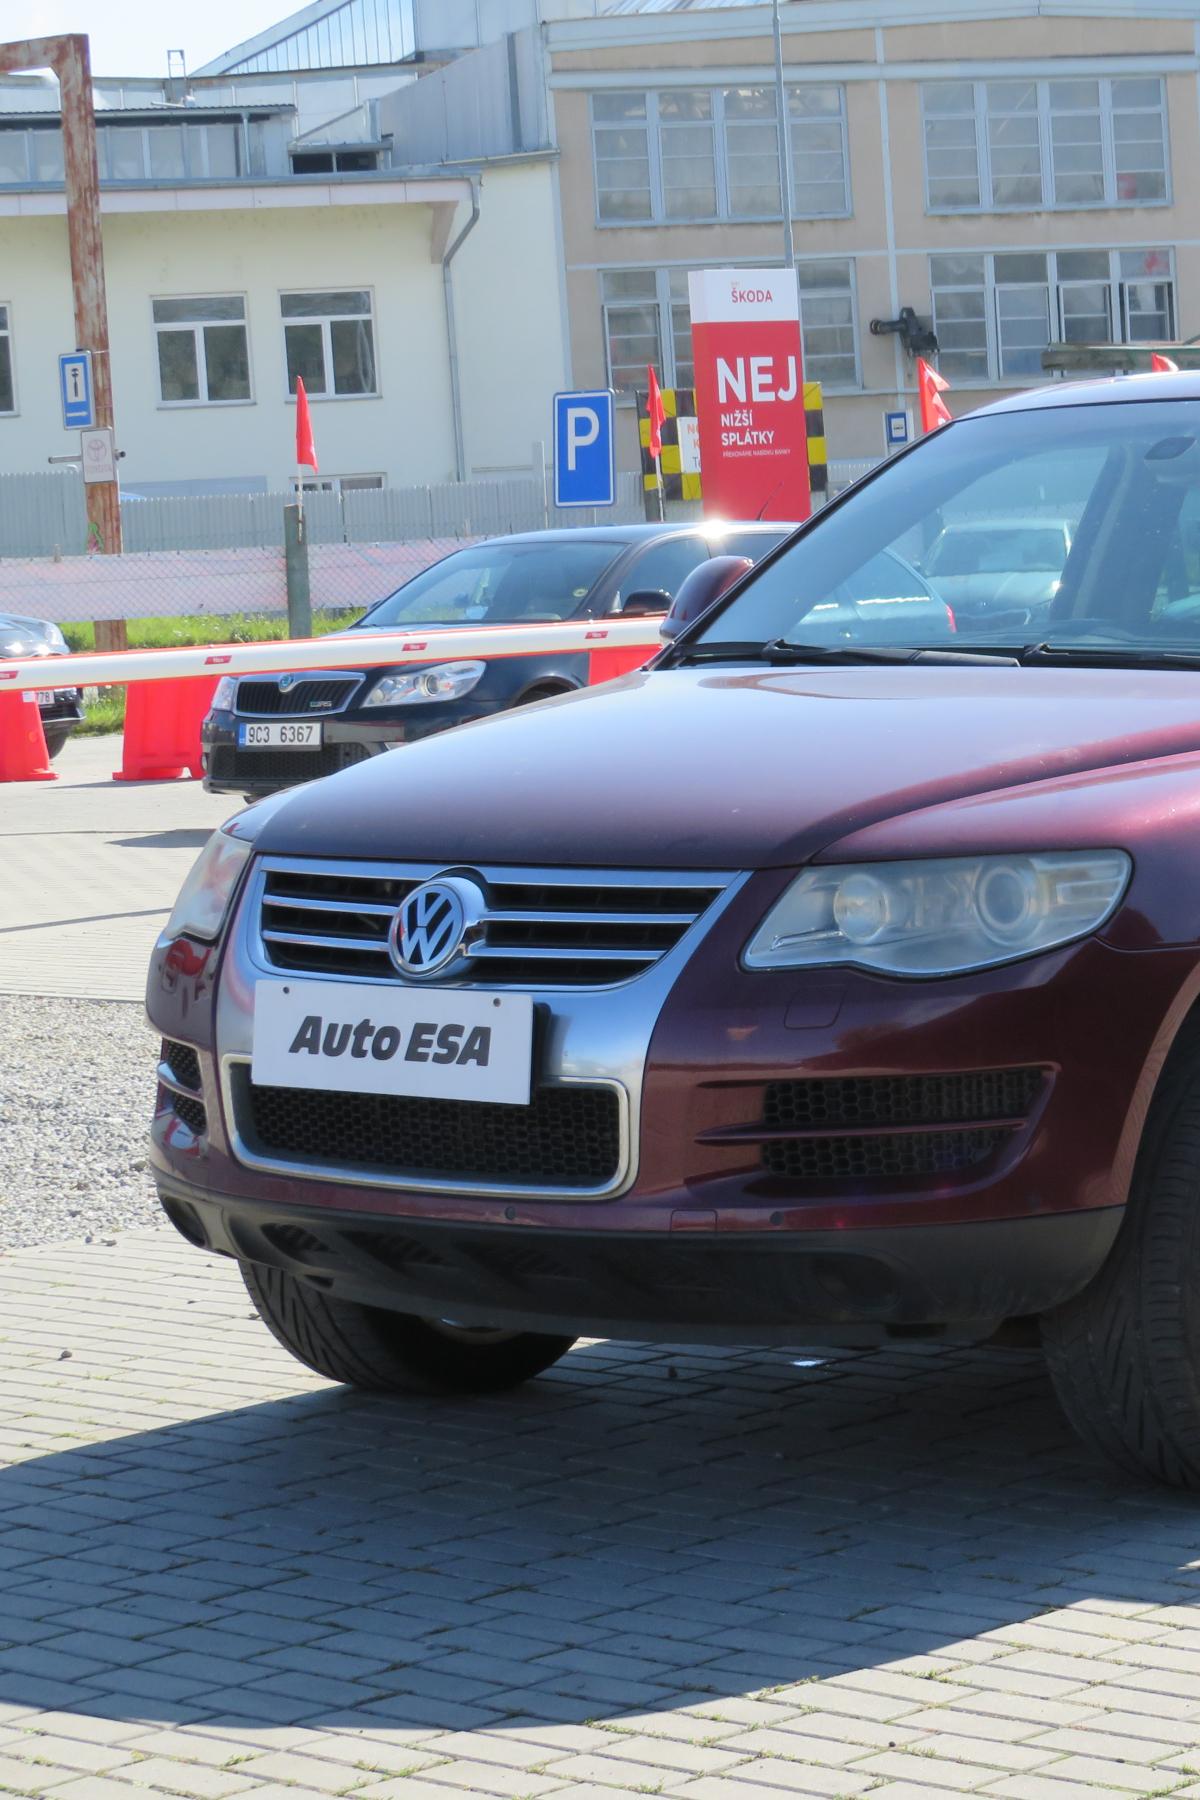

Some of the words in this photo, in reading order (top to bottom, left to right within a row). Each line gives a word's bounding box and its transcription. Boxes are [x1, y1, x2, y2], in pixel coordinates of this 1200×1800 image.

[731, 287, 773, 303] ŠKODA
[716, 355, 798, 404] NEJ
[721, 409, 753, 427] NIŽŠÍ
[567, 407, 600, 471] P
[721, 428, 775, 446] SPLÁTKY
[248, 726, 271, 744] 9C3
[280, 725, 313, 743] 6367
[288, 1015, 401, 1061] Auto
[404, 1022, 492, 1067] ESA
